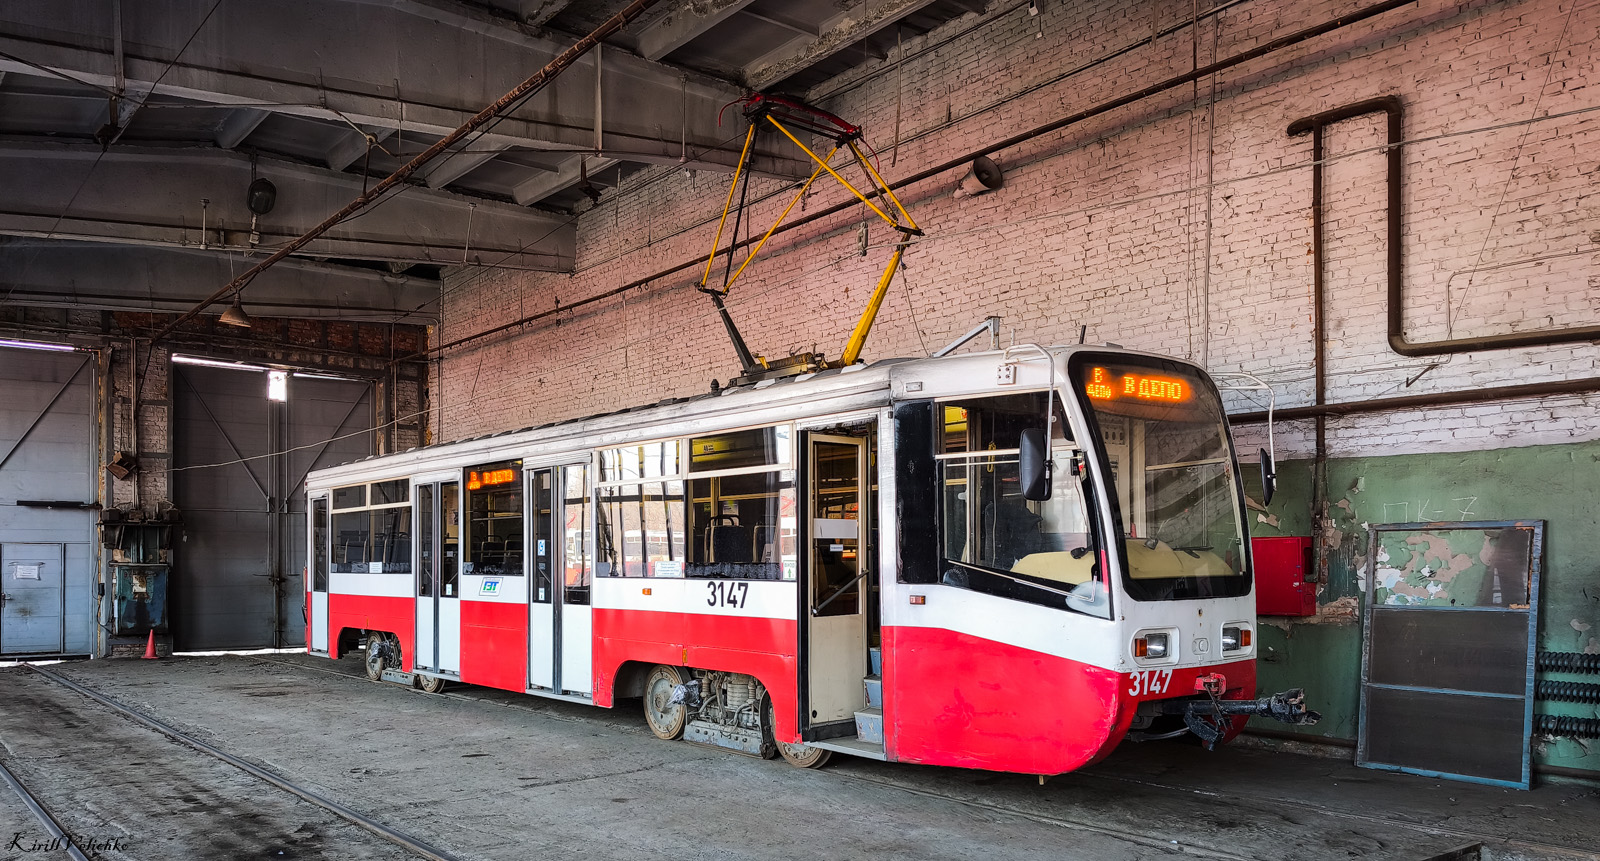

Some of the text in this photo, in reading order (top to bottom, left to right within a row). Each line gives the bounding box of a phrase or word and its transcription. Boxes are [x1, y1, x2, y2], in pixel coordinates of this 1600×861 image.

[1094, 367, 1103, 383] В
[1086, 384, 1112, 398] ДЕПО
[1123, 376, 1182, 399] В ДЕПО
[707, 581, 749, 609] 3147
[1128, 669, 1173, 697] 3147
